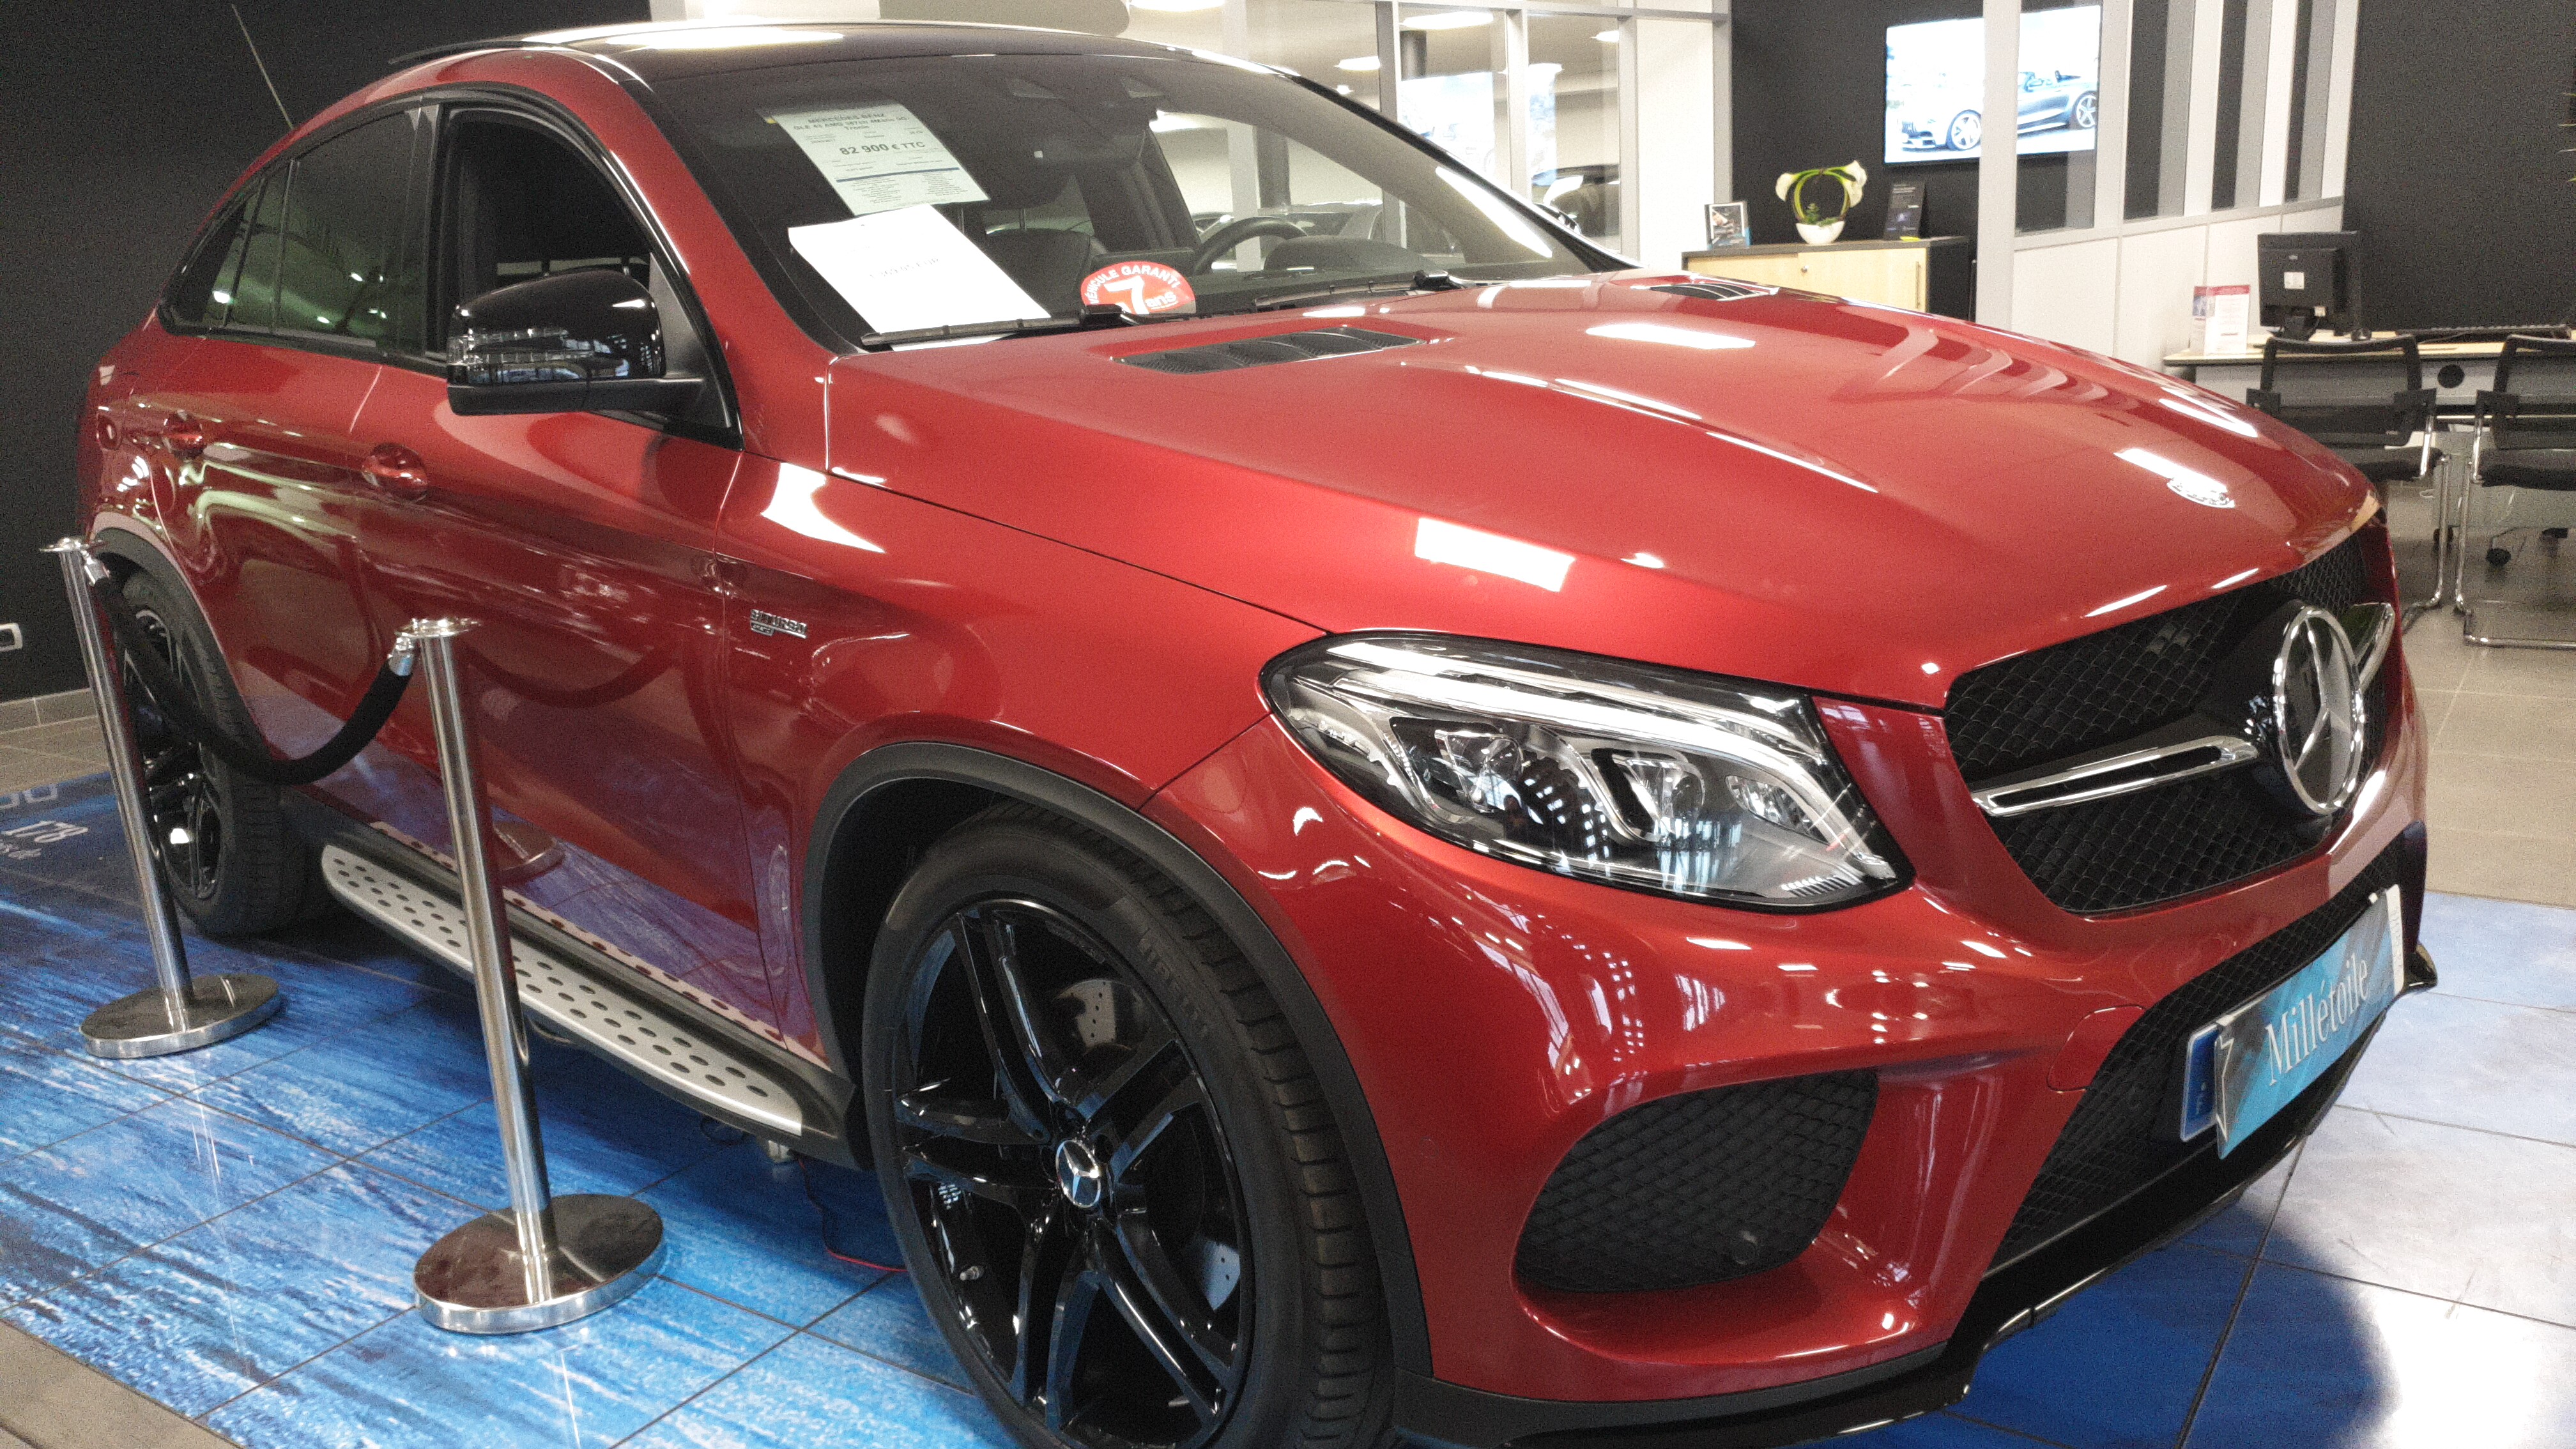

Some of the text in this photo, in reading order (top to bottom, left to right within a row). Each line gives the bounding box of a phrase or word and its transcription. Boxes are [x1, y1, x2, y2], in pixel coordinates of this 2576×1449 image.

[839, 146, 859, 155] 82
[861, 144, 889, 153] 900
[901, 141, 926, 150] TTC
[1084, 264, 1181, 305] VÉHICULE GARANTI
[1103, 275, 1177, 314] 7 ans
[2265, 953, 2370, 1087] Millétoile
